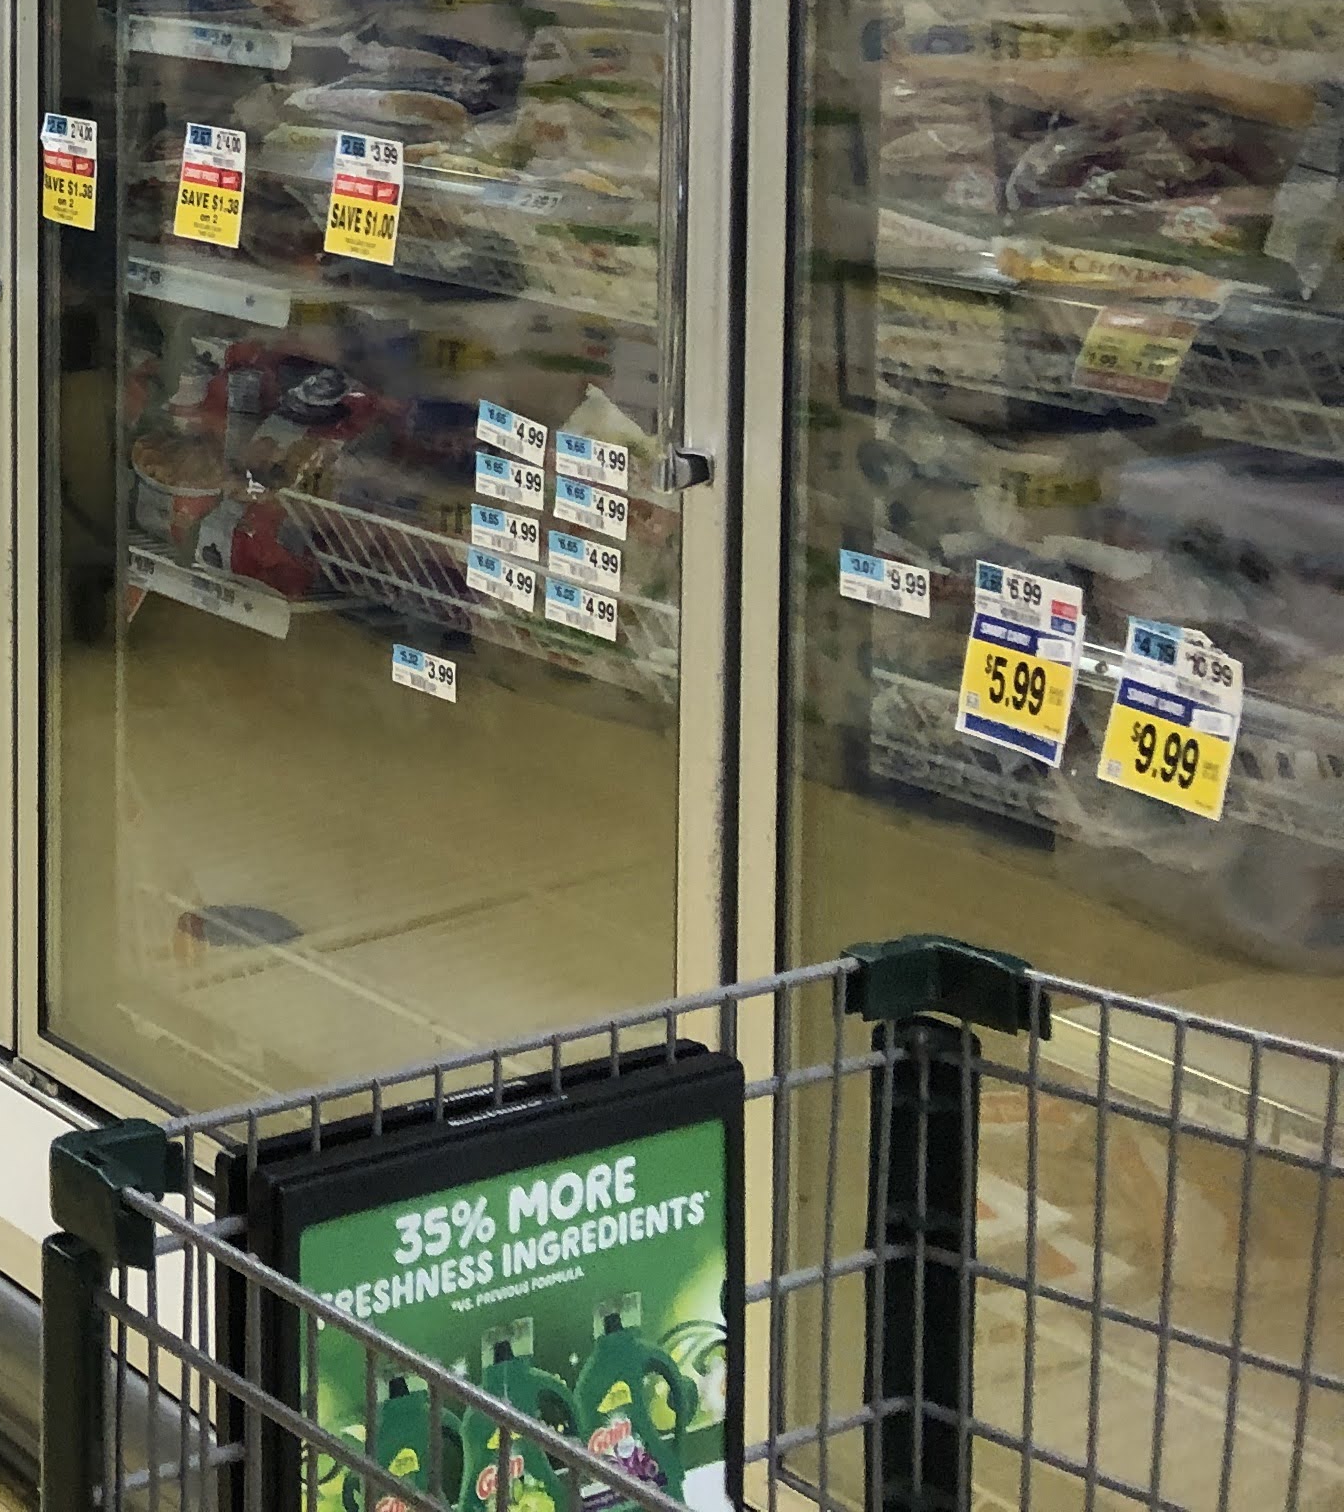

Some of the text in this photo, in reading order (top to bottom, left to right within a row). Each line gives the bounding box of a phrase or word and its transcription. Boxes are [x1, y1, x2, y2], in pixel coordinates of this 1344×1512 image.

[57, 199, 68, 208] on
[180, 188, 210, 210] SAVE
[199, 214, 210, 224] on
[330, 202, 396, 241] SAVE $1.00
[985, 652, 1047, 716] $5.99
[1130, 721, 1201, 790] $9.99
[394, 1155, 637, 1265] 35% MORE
